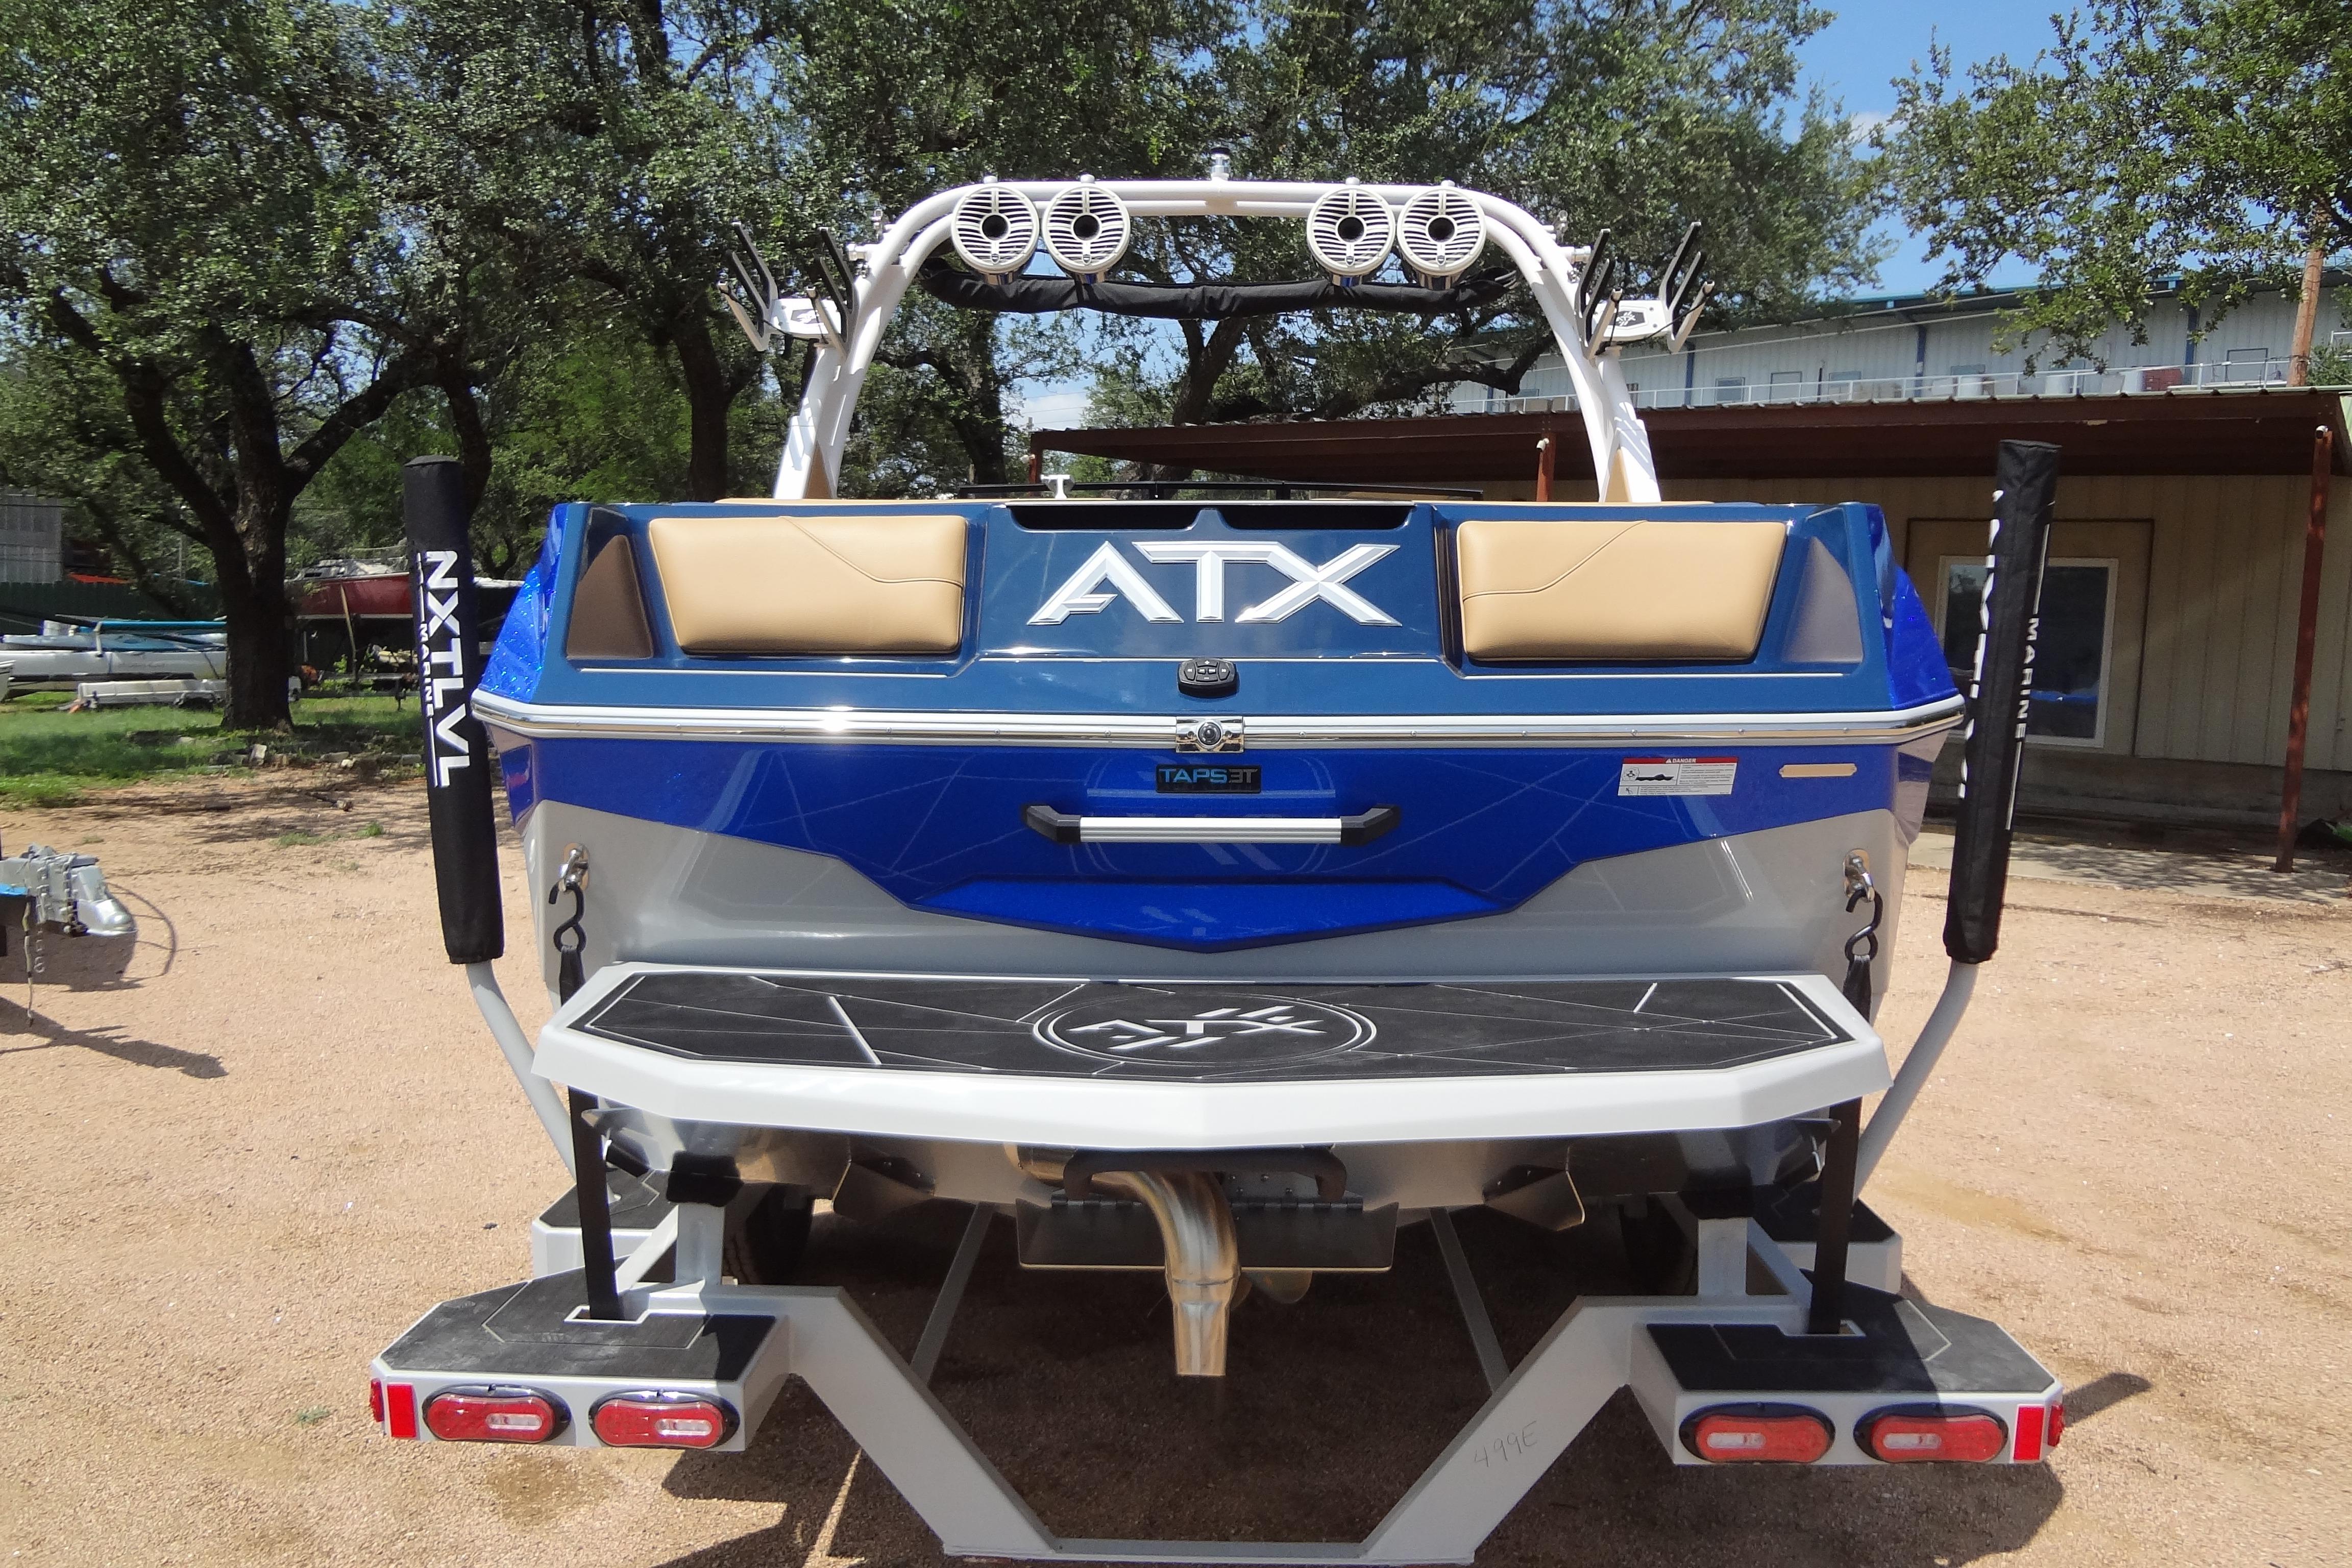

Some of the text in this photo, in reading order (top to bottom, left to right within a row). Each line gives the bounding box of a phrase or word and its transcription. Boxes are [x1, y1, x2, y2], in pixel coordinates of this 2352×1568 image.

[1026, 541, 1403, 626] ATX
[419, 623, 434, 717] MARINE
[425, 550, 470, 787] NXTLVL
[2015, 618, 2040, 738] MARINE
[1474, 1420, 1537, 1467] 499E
